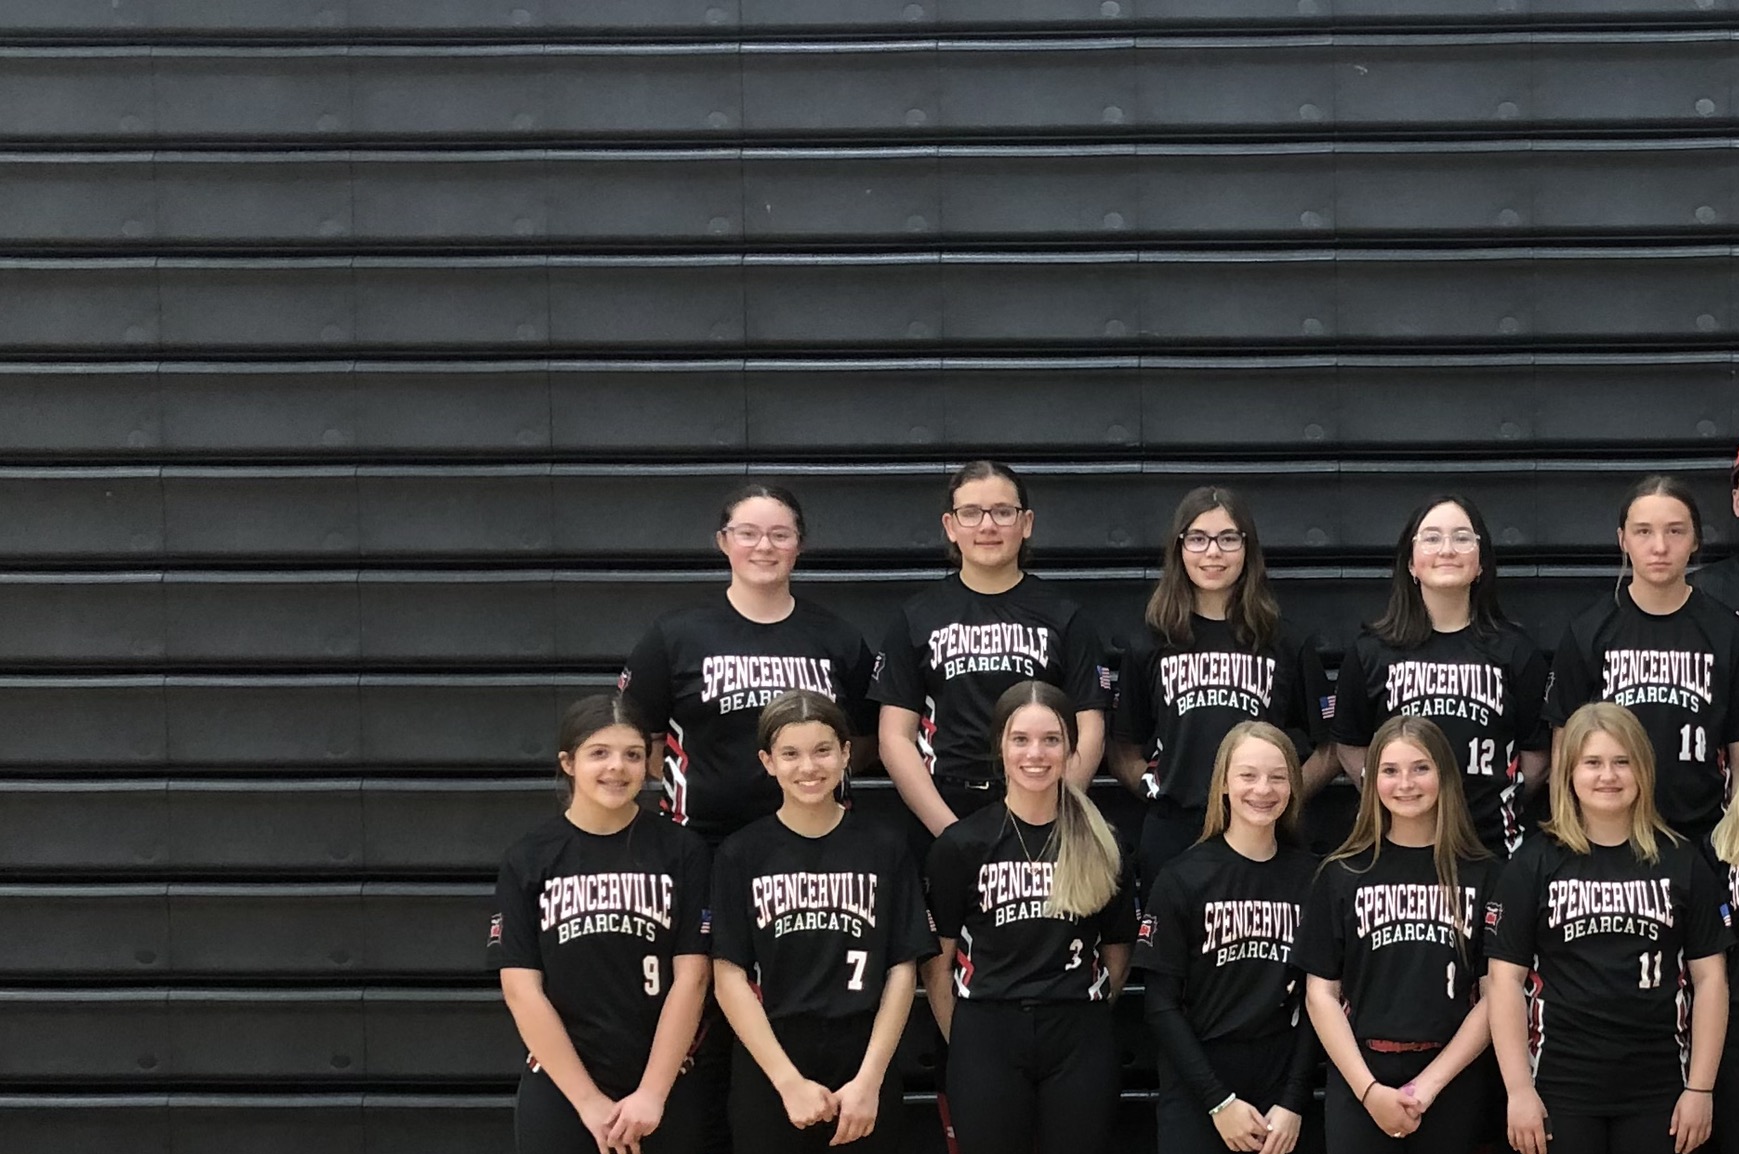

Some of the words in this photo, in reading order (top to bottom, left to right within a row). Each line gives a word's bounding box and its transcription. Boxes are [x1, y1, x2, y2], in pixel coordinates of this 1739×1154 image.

[929, 623, 1048, 669] SPENCERVILLE
[701, 655, 837, 703] SPENCERVILLE
[945, 654, 1033, 680] BEARCATS
[1160, 651, 1275, 710] SPENCERVILLE
[1602, 648, 1713, 704] SPENCERVILLE
[1177, 689, 1260, 717] BEARCATS
[1387, 663, 1504, 715] SPENCERVILLE
[1615, 684, 1699, 712] BEARCATS
[1402, 696, 1489, 727] BEARCATS
[1468, 738, 1494, 775] 12
[1679, 725, 1705, 762] 18
[539, 872, 673, 932] SPENCERVILLE
[752, 872, 877, 930] SPENCERVILLE
[1355, 885, 1476, 938] SPENCERVILLE
[1548, 877, 1674, 927] SPENCERVILLE
[557, 912, 656, 944] BEARCATS
[774, 912, 861, 938] BEARCATS
[1372, 923, 1454, 951] BEARCATS
[1564, 917, 1659, 942] BEARCATS
[846, 951, 867, 990] 7
[1217, 943, 1291, 967] BEARCAT
[1639, 952, 1664, 988] 11
[642, 955, 660, 996] 9
